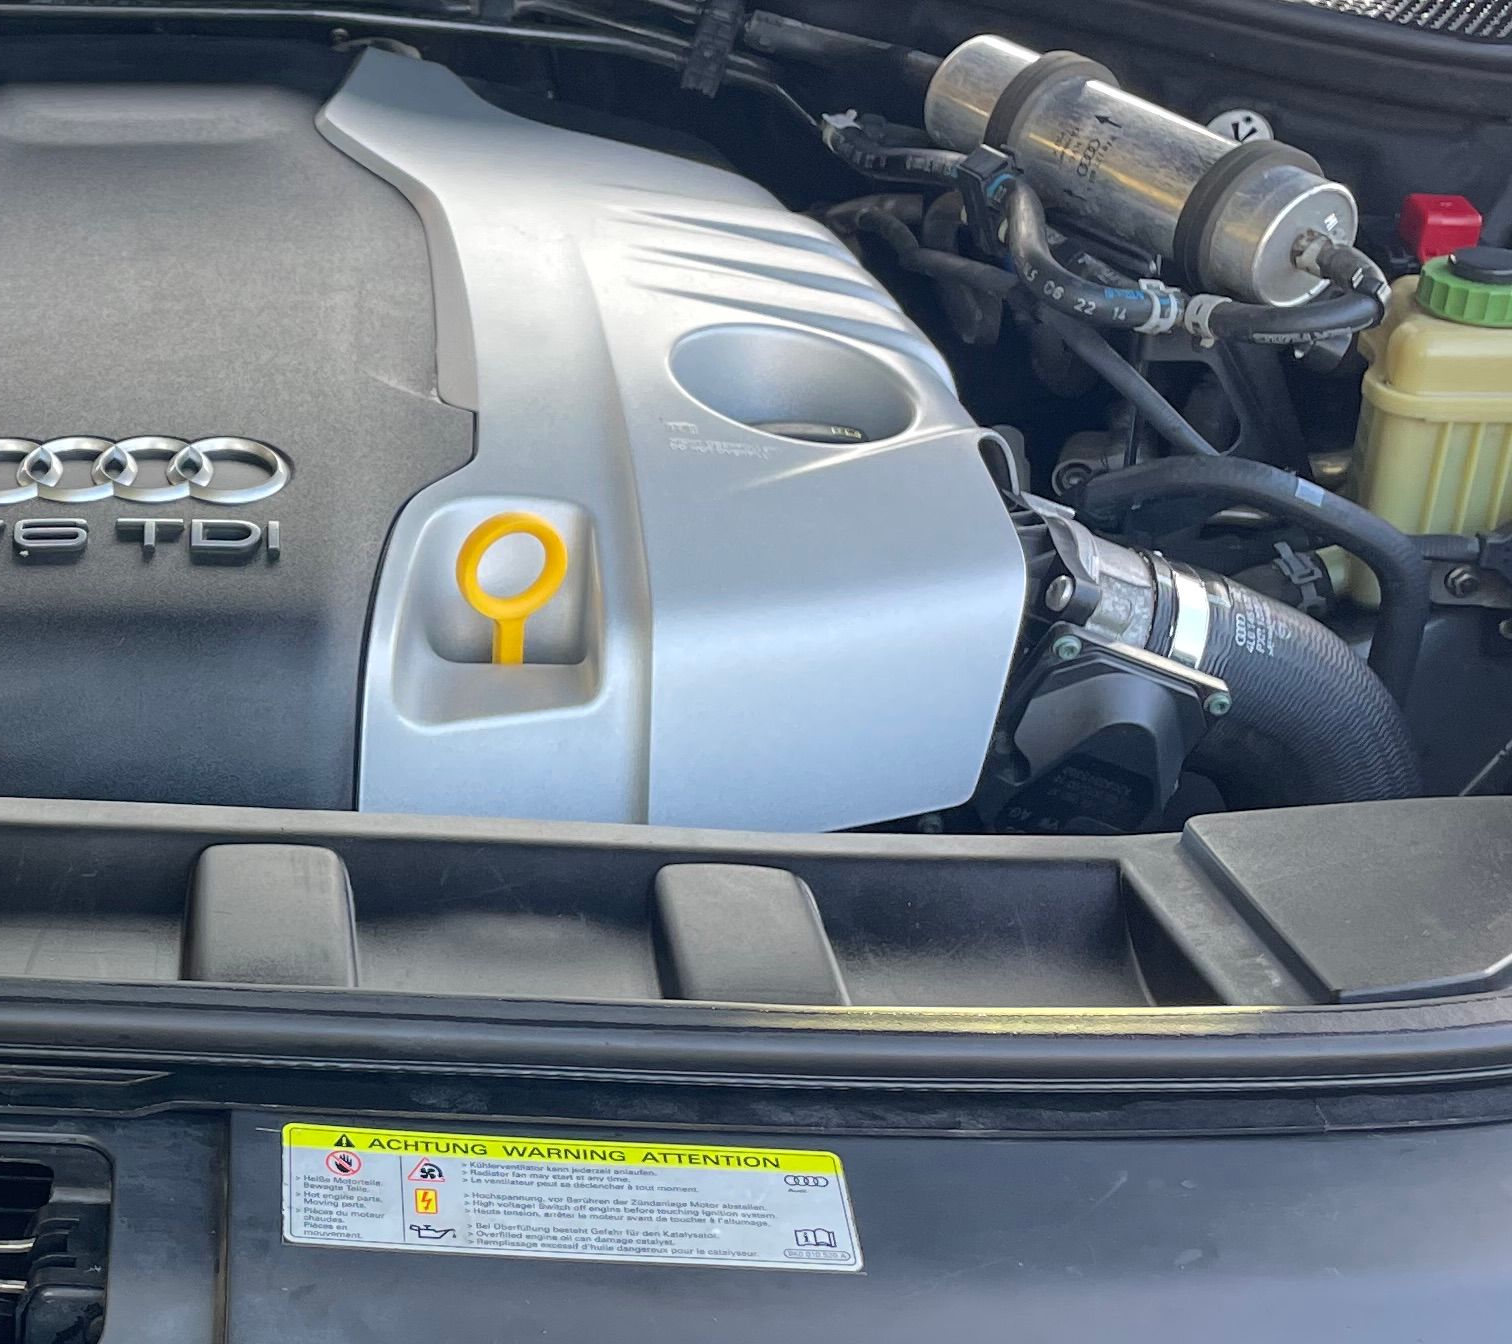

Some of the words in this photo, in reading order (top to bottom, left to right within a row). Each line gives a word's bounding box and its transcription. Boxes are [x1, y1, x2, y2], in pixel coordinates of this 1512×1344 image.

[1073, 297, 1096, 315] 22
[115, 517, 281, 560] TDI
[367, 1136, 488, 1156] ACHTUNG
[501, 1144, 626, 1163] WARNING
[641, 1152, 780, 1169] ATTENTION
[470, 1169, 510, 1178] Radiator
[530, 1173, 550, 1181] may
[546, 1165, 569, 1173] kann
[303, 1182, 343, 1191] Bewegte
[484, 1178, 534, 1187] ventilateur
[537, 1181, 557, 1189] peut
[303, 1198, 339, 1207] Moving
[323, 1193, 354, 1201] engine
[566, 1196, 610, 1205] Berühren
[613, 1198, 629, 1206] der
[631, 1199, 688, 1208] Zündanlage
[690, 1201, 719, 1209] Motor
[472, 1200, 495, 1208] High
[539, 1203, 571, 1211] Switch
[588, 1205, 621, 1213] engine
[624, 1207, 655, 1215] before
[657, 1208, 699, 1217] touching
[351, 1211, 385, 1219] moteur
[589, 1213, 624, 1221] moteur
[670, 1216, 707, 1224] toucher
[475, 1222, 491, 1230] Bei
[553, 1226, 589, 1234] besteht
[590, 1227, 624, 1236] Gefahr
[626, 1229, 639, 1237] für
[476, 1230, 523, 1239] Overfilled
[525, 1233, 558, 1241] engine
[594, 1236, 634, 1245] damage
[477, 1238, 538, 1248] Remplissage
[617, 1245, 668, 1254] dangereux
[671, 1248, 694, 1256] pour
